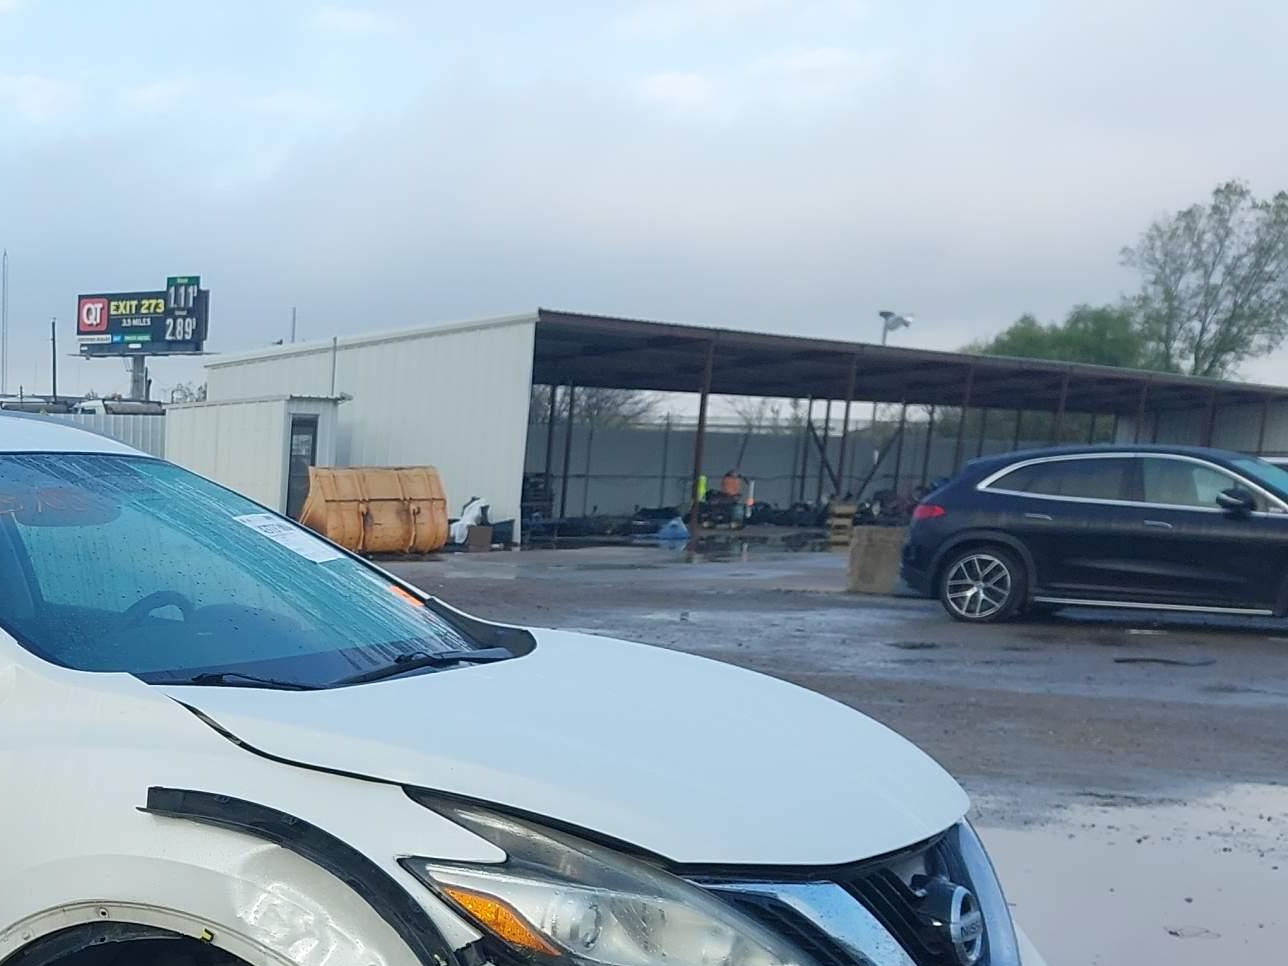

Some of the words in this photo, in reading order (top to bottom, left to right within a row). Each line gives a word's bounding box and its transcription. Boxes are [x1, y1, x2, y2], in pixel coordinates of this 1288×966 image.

[111, 301, 138, 314] EXIT
[142, 300, 165, 314] 273
[83, 303, 103, 326] QT
[133, 318, 151, 326] MILES
